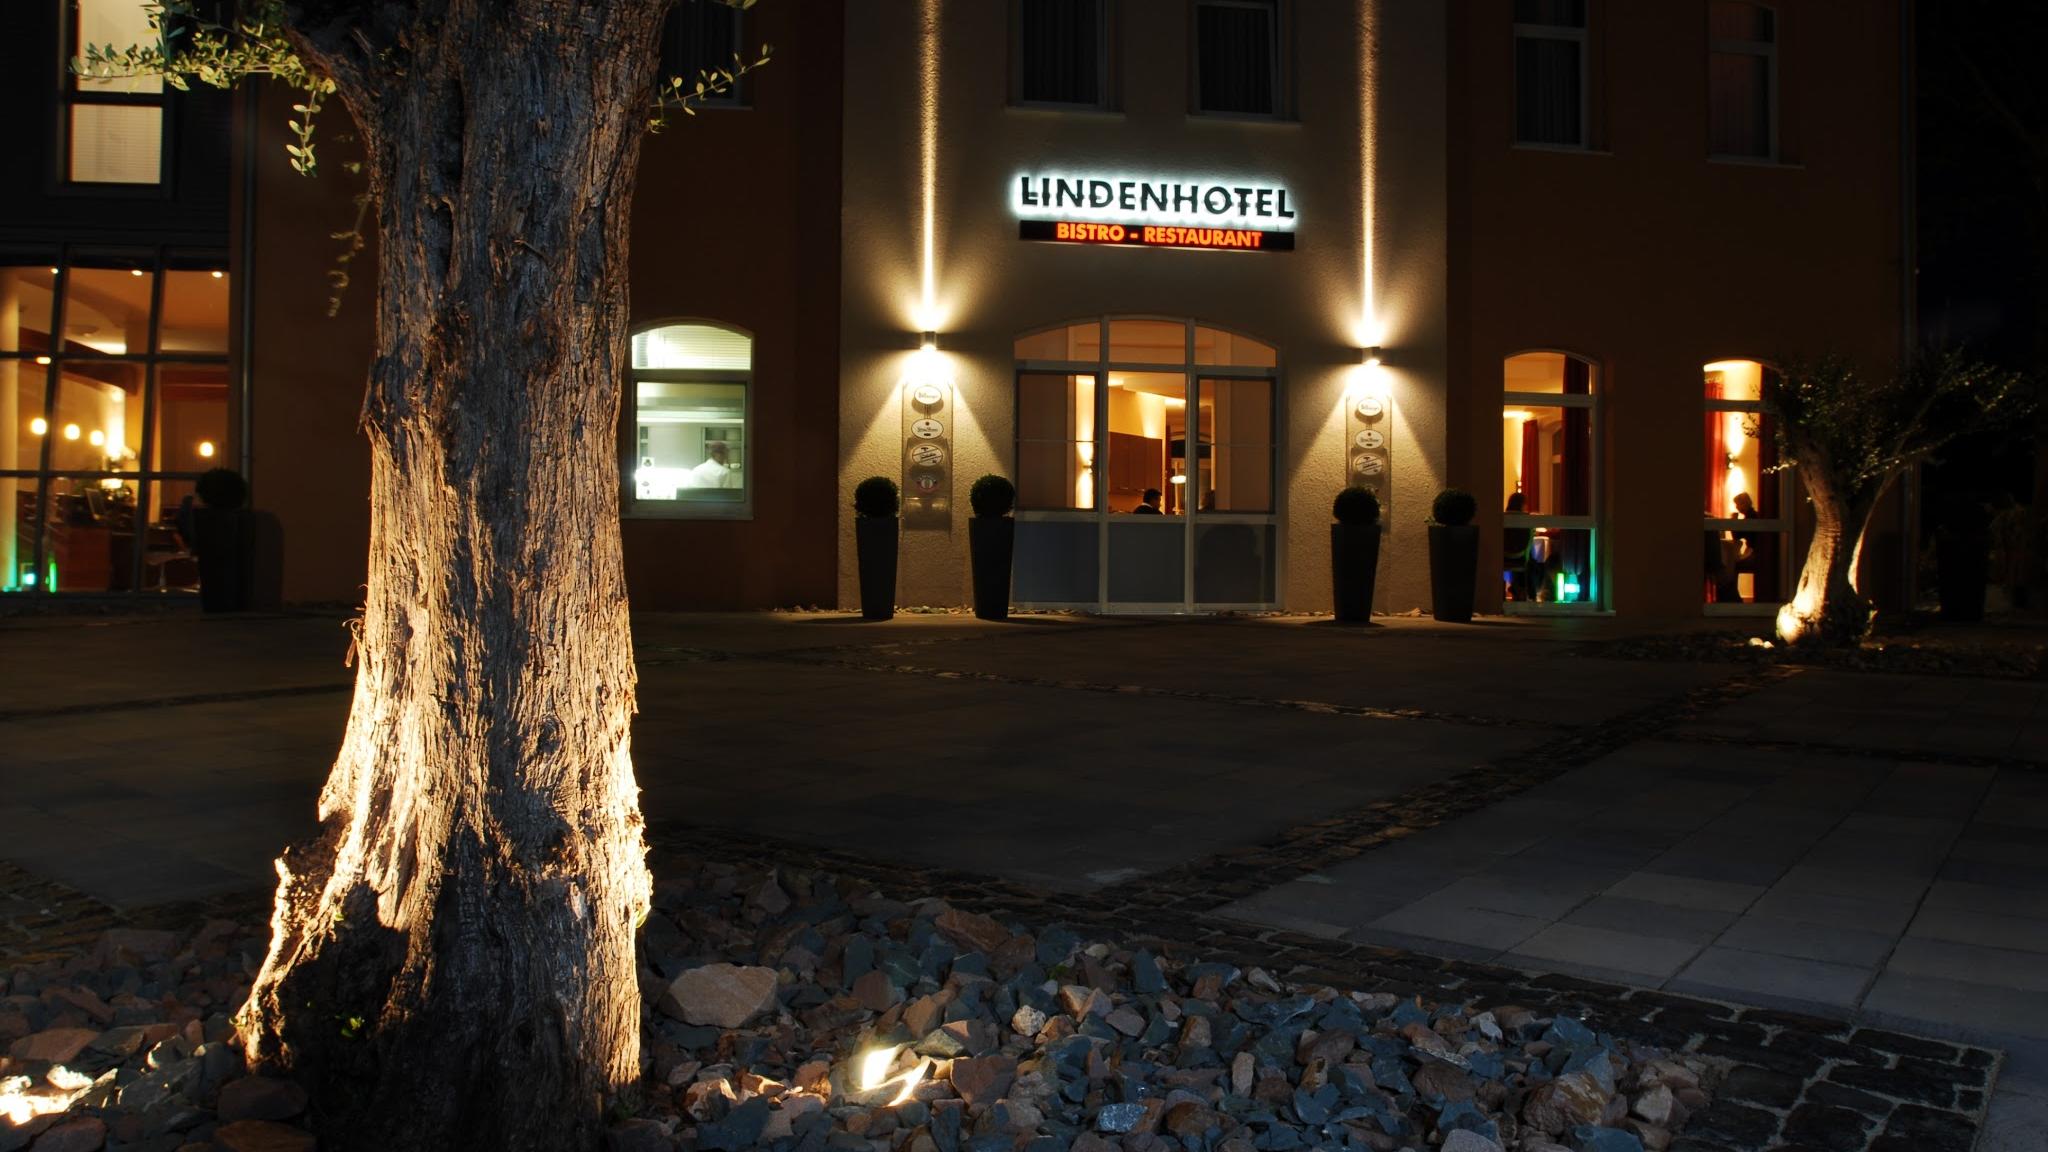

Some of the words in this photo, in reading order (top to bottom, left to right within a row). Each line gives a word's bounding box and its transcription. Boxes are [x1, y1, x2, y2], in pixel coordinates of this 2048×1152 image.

[1021, 176, 1294, 218] LINDENHOTEL
[1056, 221, 1125, 242] BISTRO
[1144, 225, 1263, 248] RESTAURANT
